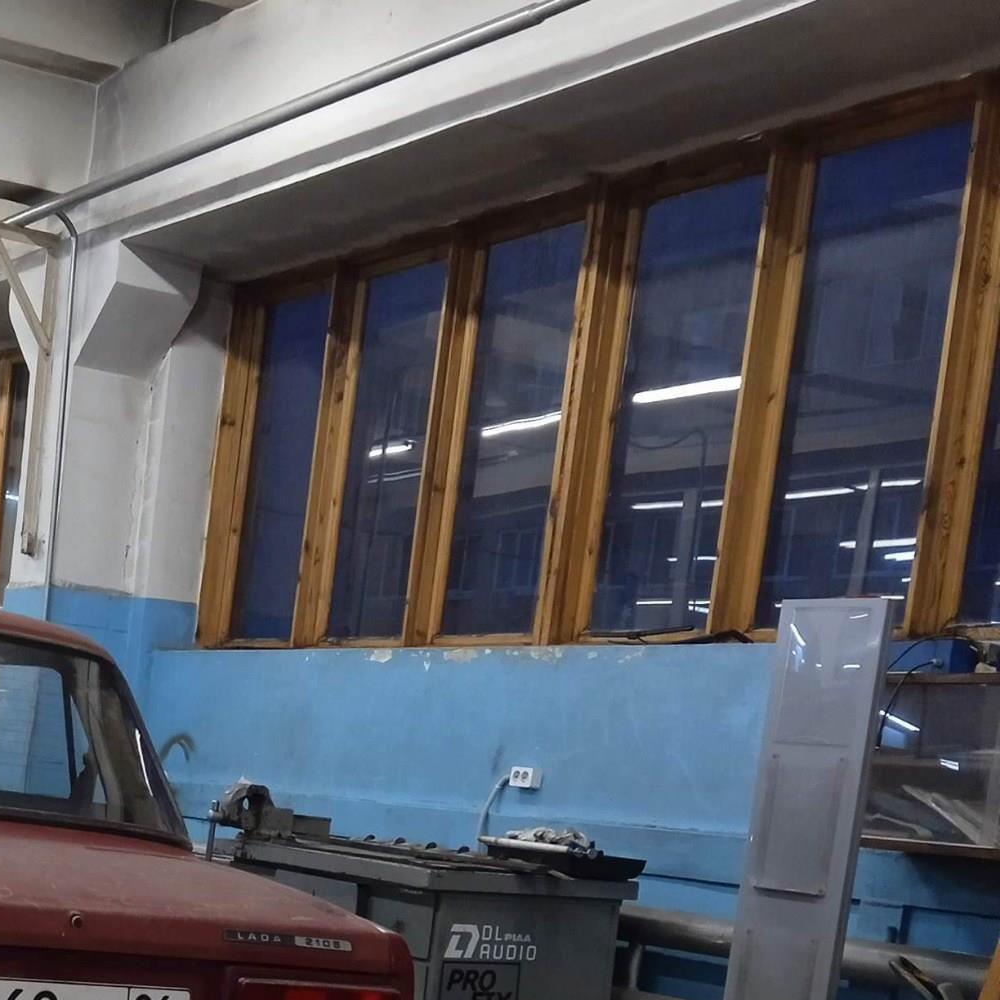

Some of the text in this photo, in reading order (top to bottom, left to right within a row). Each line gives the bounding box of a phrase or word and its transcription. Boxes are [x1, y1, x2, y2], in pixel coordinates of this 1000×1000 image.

[237, 932, 281, 942] LADA
[482, 925, 502, 941] DL
[480, 944, 537, 961] AUDIO
[446, 969, 497, 992] PRO
